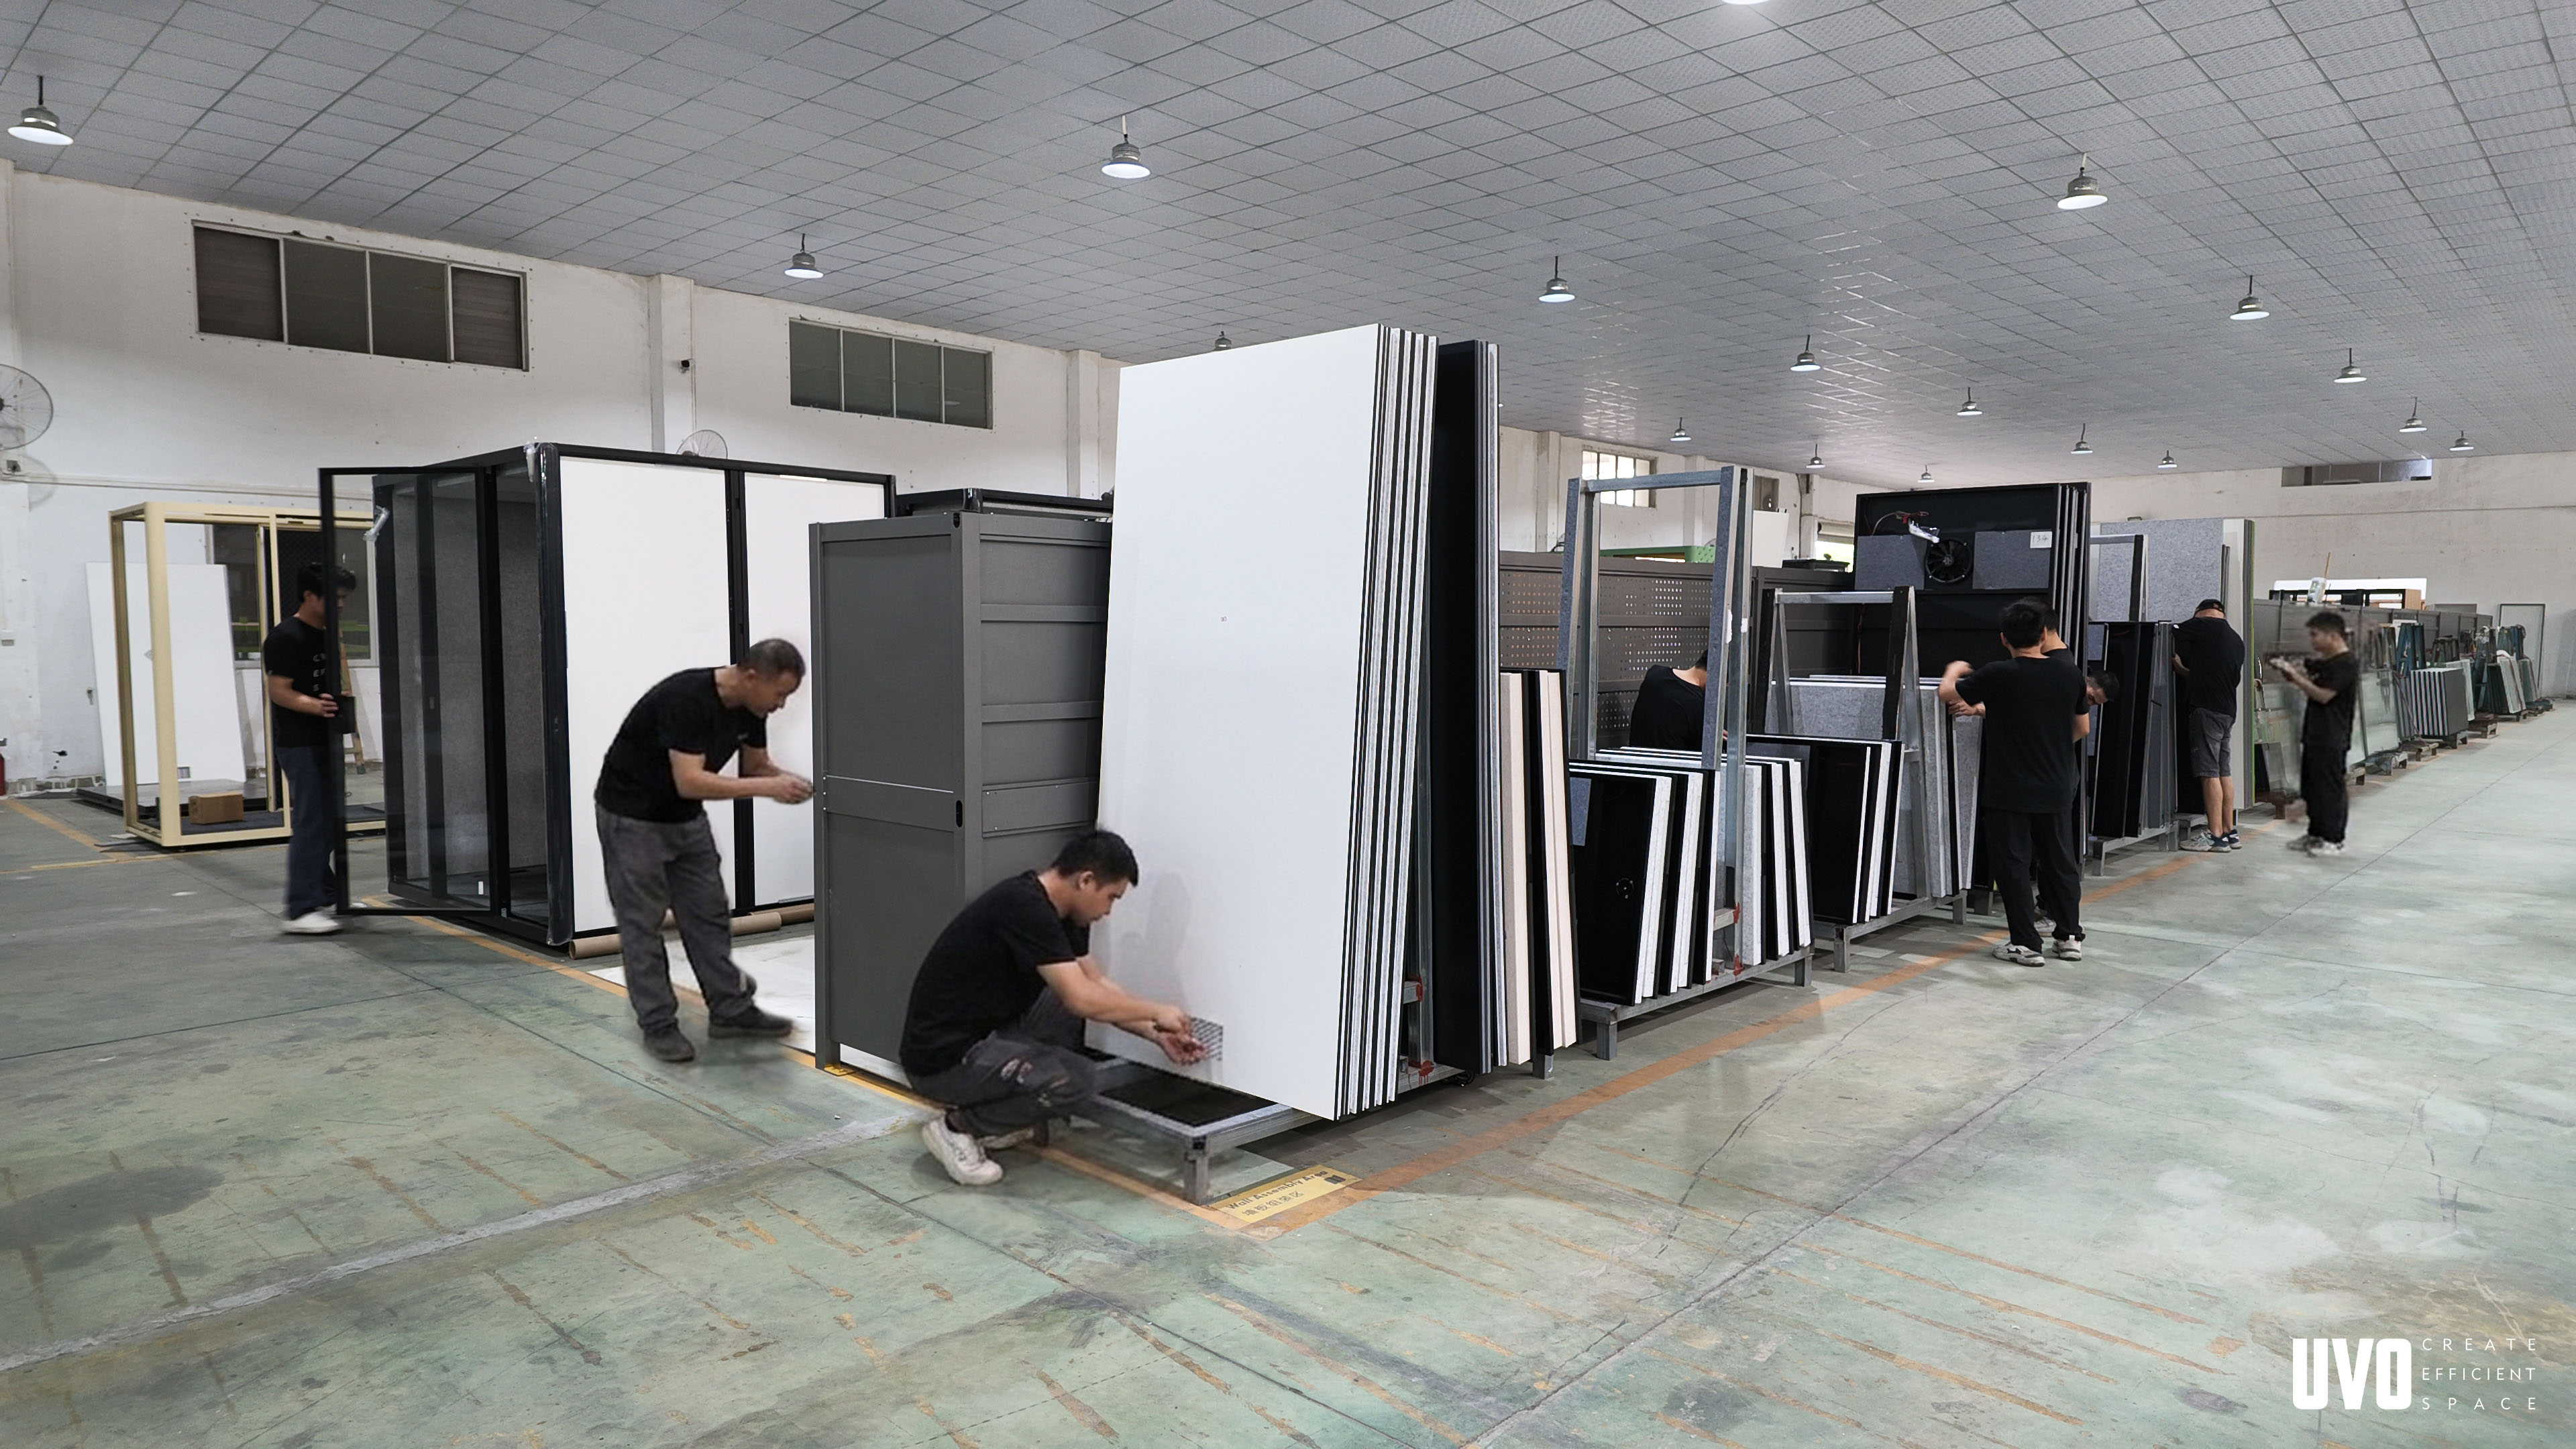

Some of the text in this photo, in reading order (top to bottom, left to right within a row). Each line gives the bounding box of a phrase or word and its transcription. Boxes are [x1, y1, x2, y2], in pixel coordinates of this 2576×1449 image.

[1226, 1170, 1328, 1210] Wall Assembly Area
